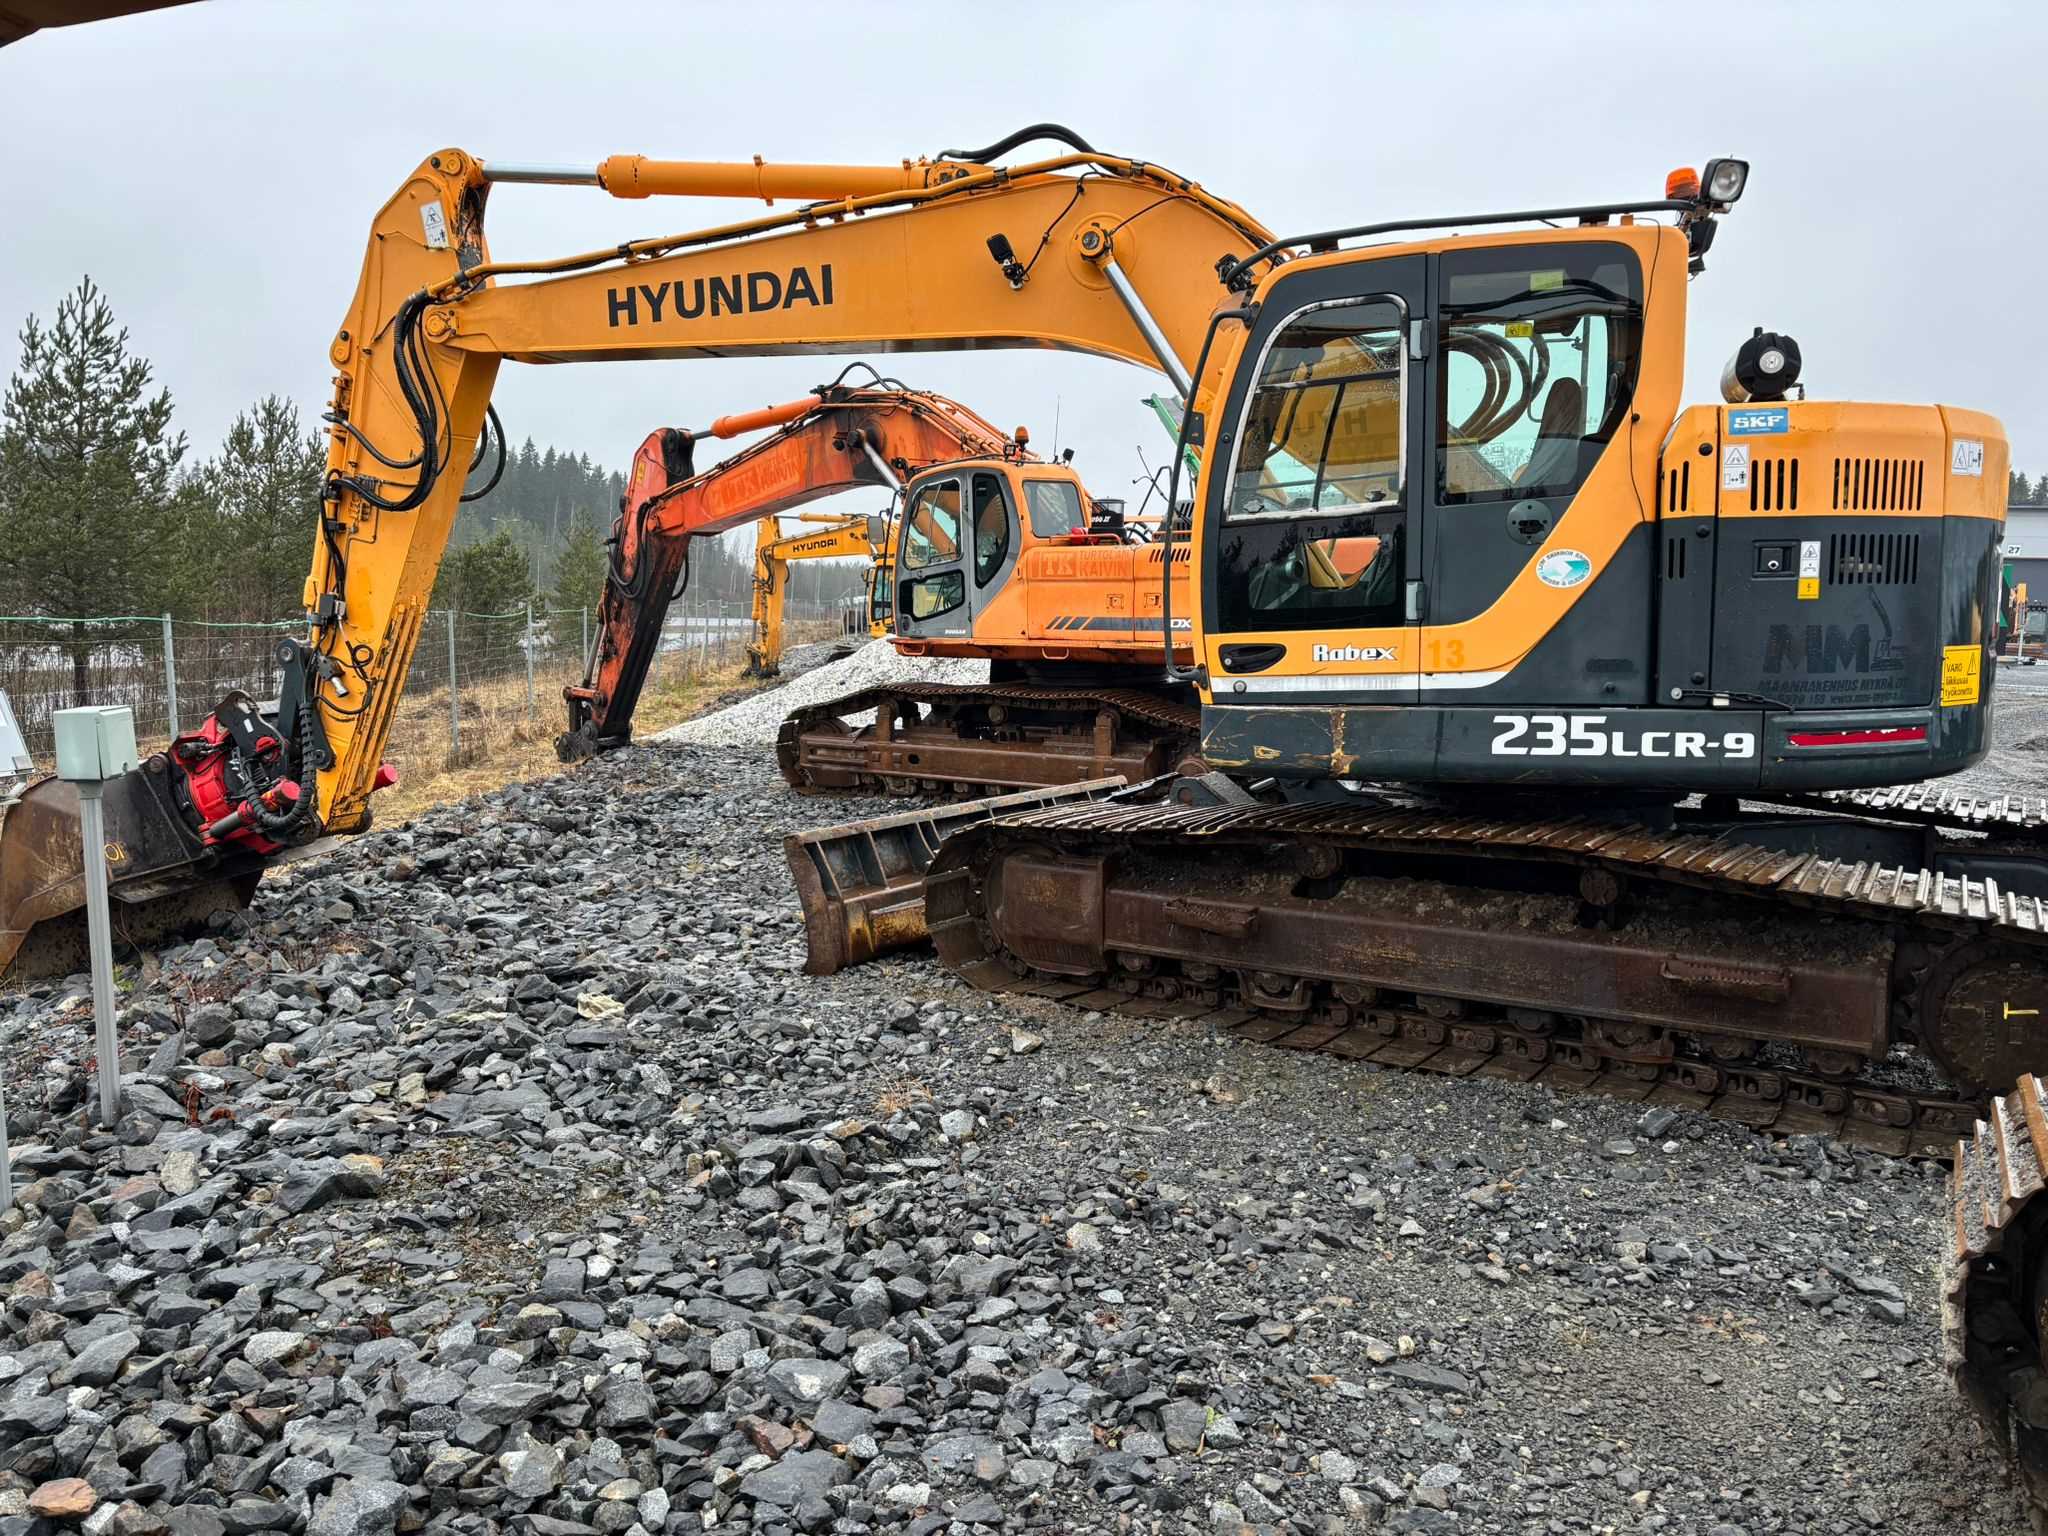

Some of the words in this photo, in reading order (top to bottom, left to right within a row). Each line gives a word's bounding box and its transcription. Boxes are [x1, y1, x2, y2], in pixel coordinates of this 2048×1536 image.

[607, 263, 834, 328] HYUNDAI
[1733, 415, 1785, 429] SKF
[792, 537, 838, 553] HYUNDAI
[2008, 546, 2021, 554] 27
[1312, 643, 1398, 662] Robex
[1427, 639, 1465, 668] 13
[1946, 663, 1963, 673] VARO
[1491, 715, 1755, 758] 235LCR-9
